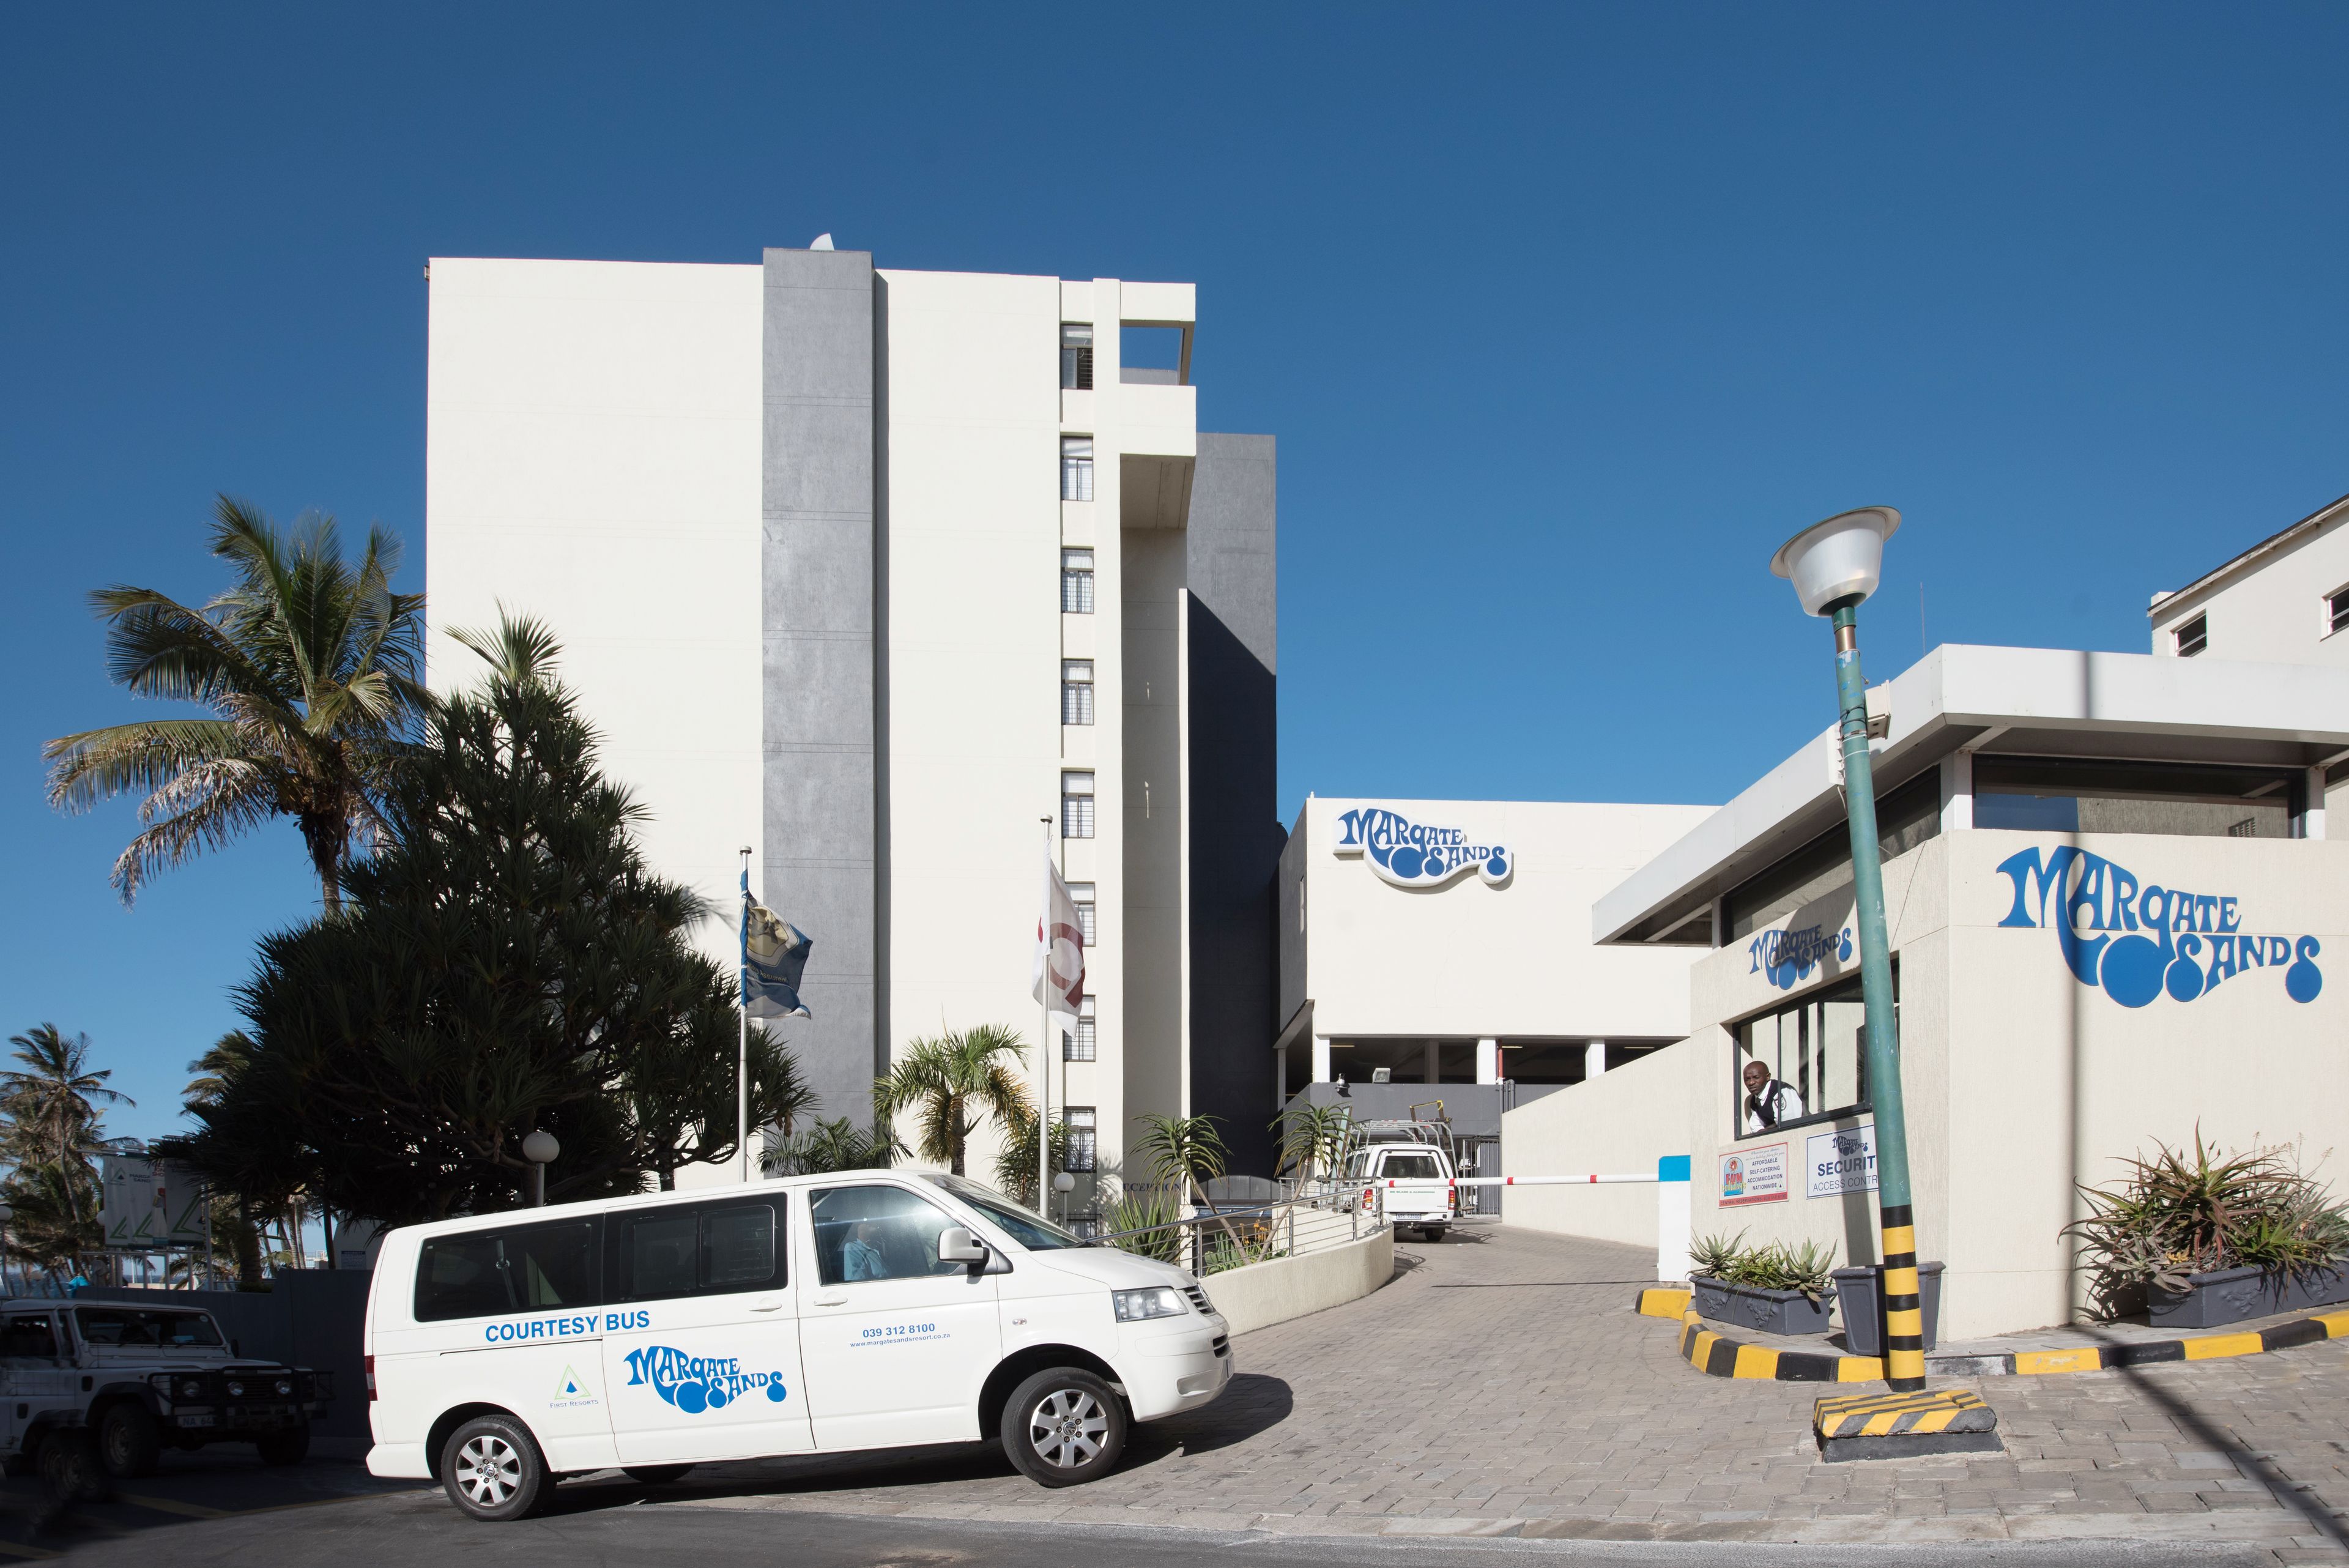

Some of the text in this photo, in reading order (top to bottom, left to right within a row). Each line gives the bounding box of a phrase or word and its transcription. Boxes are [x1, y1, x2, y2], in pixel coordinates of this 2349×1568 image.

[1424, 845, 1507, 877] SANDS
[1797, 927, 1853, 981] SANDS
[2165, 932, 2323, 1003] SANDS
[1850, 1142, 1868, 1154] SANDS
[1752, 1157, 1778, 1166] AFFORDABLE
[1817, 1155, 1876, 1176] SECURIT
[1750, 1165, 1780, 1175] SELF-CATERING
[1726, 1172, 1742, 1185] FUN
[1747, 1173, 1783, 1183] ACCOMMODATION
[1813, 1175, 1877, 1192] ACCESS CONTR
[1123, 1183, 1182, 1192] ECEPTION
[1752, 1183, 1777, 1191] NATIONWIDE
[486, 1310, 650, 1342] COURTESY BUS
[863, 1323, 935, 1338] 039 312 8100
[850, 1333, 951, 1348] www.margatesandsresort.co.za
[707, 1371, 787, 1409] SANDS
